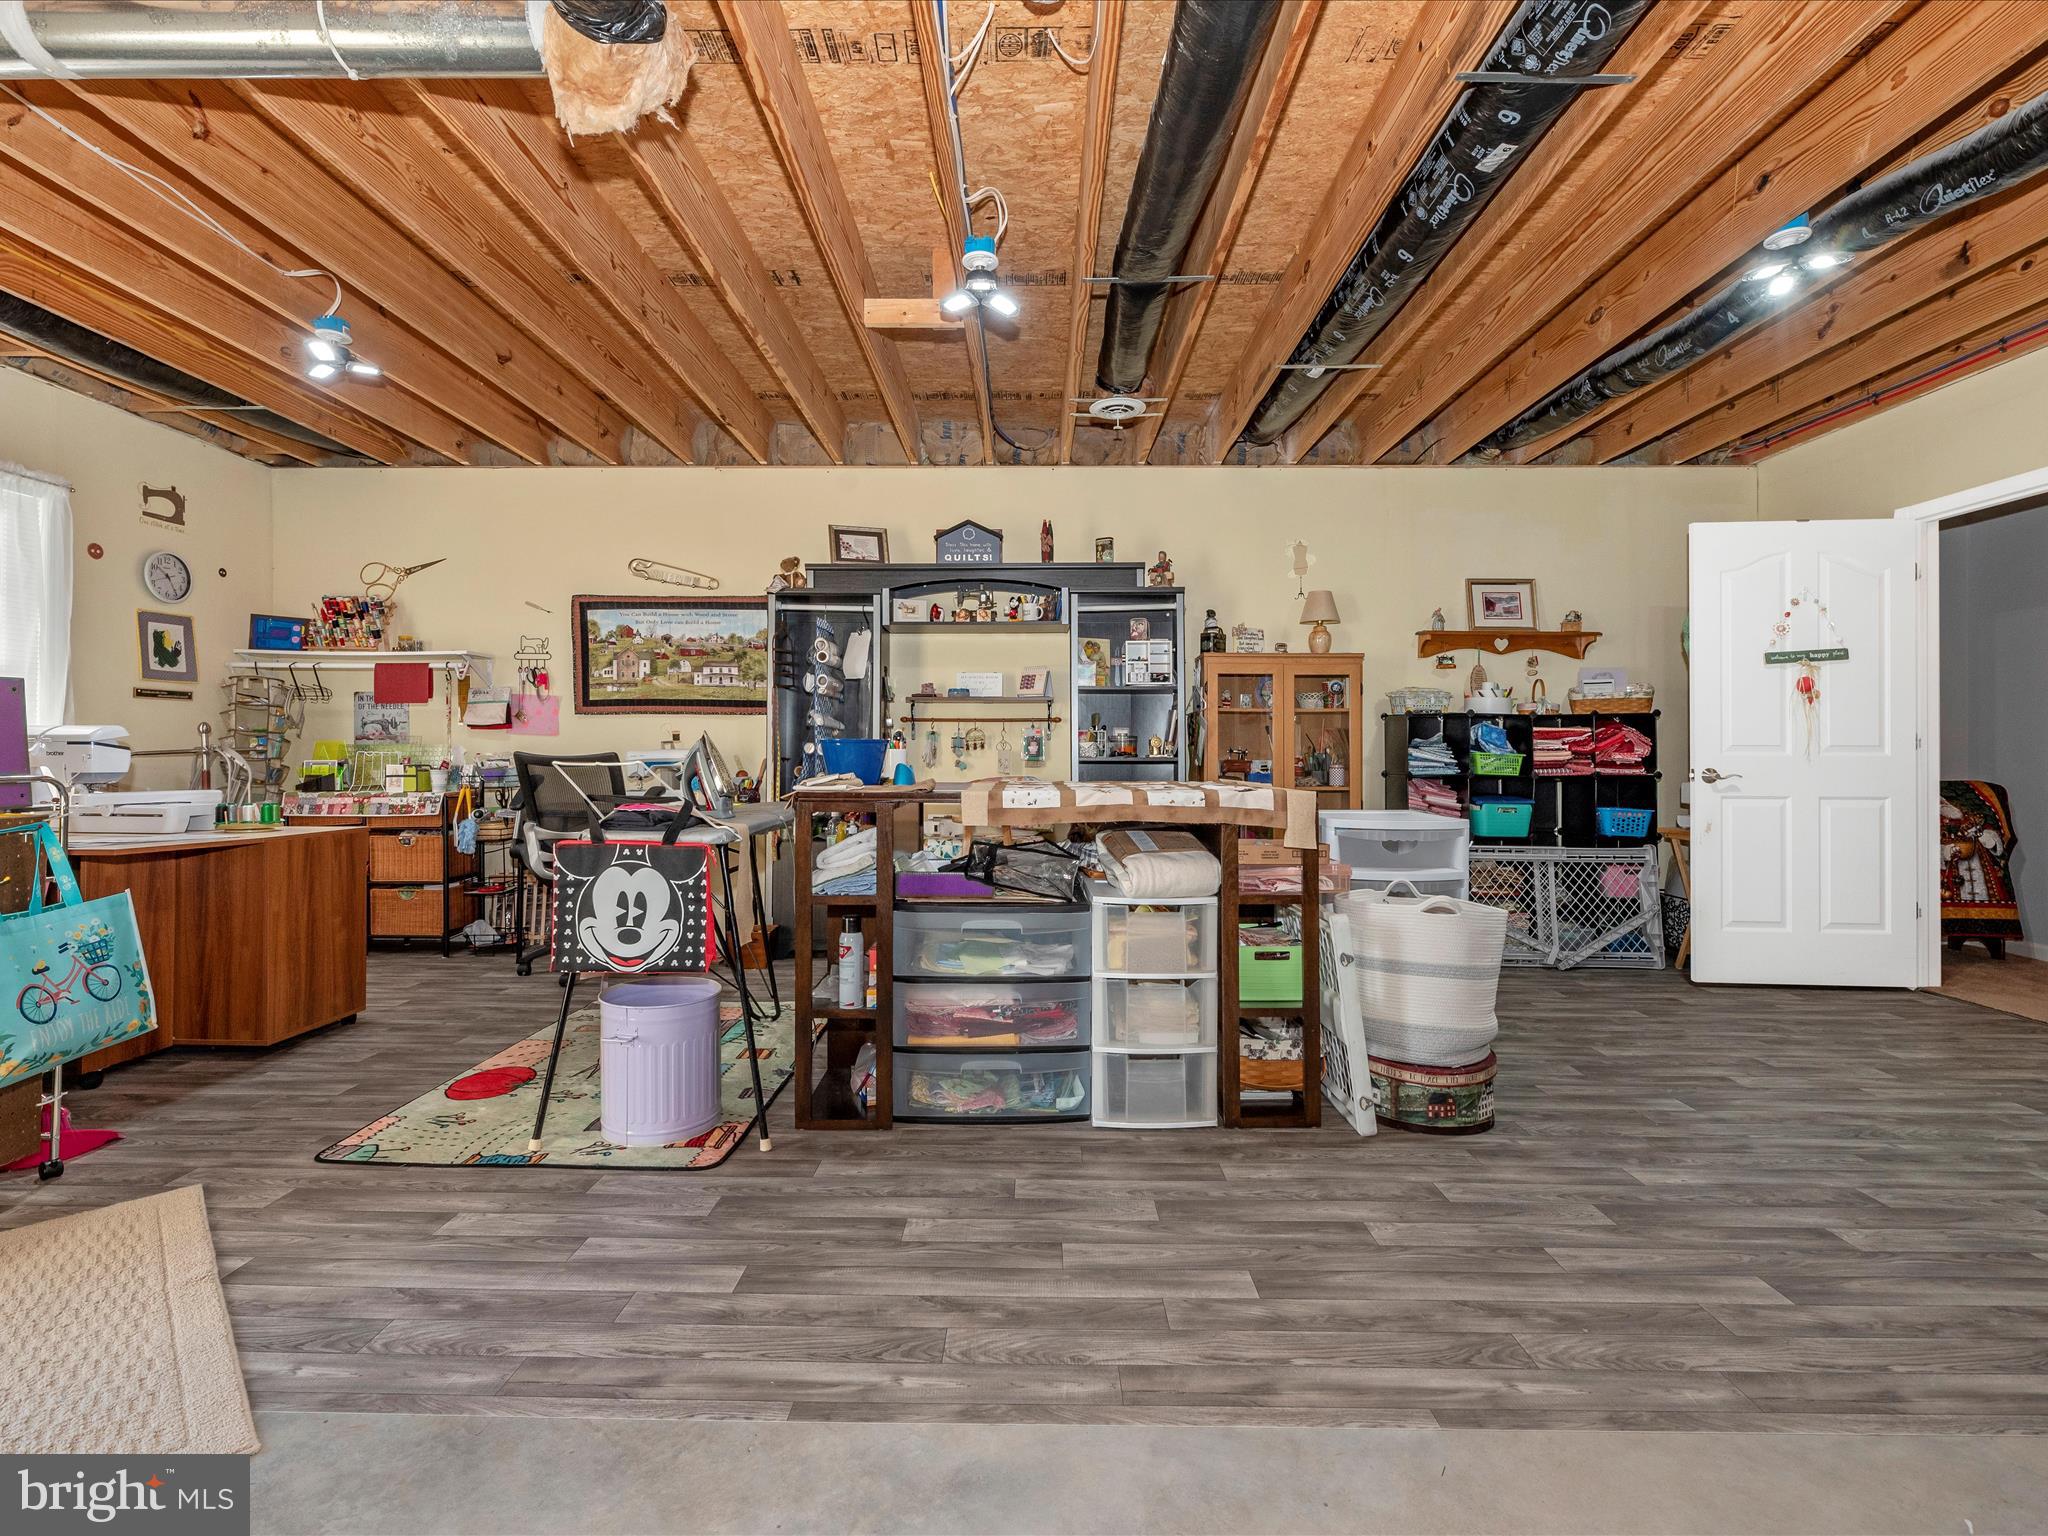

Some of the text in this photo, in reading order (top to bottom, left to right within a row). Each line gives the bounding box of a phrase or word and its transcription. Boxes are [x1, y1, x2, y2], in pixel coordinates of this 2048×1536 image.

[1919, 169, 1998, 214] Quietflex
[1885, 207, 1910, 225] R-4.2
[1727, 311, 1740, 324] 4
[944, 554, 993, 562] QUILTS!
[358, 694, 364, 702] IN
[31, 997, 131, 1052] ENJOY THE RIDE
